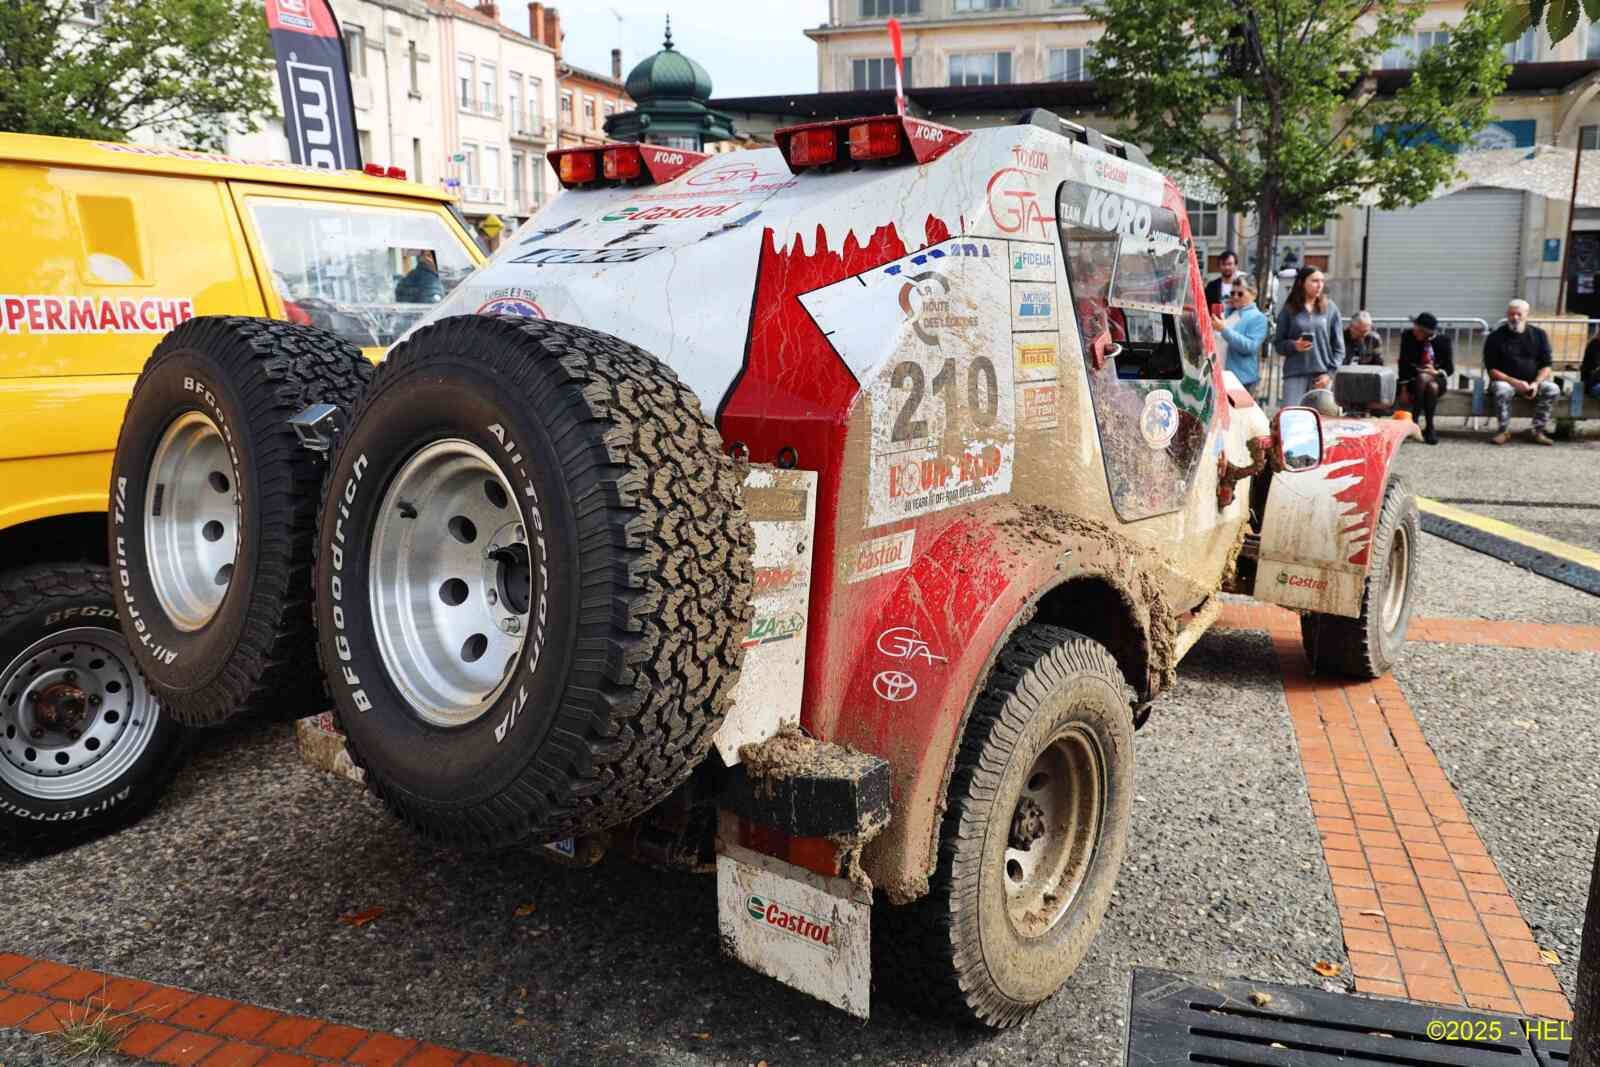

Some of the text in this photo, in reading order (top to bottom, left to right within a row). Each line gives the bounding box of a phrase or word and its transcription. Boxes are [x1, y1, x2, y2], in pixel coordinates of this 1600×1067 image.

[914, 125, 944, 142] KORO
[653, 151, 684, 165] KORO
[1012, 145, 1049, 172] TOYOTA
[628, 201, 743, 221] Castrol
[1083, 188, 1152, 236] KORO
[1022, 252, 1052, 267] FIDELIA
[890, 355, 999, 443] 210
[183, 376, 242, 549] BFGoo
[857, 541, 905, 573] Castrol
[116, 537, 178, 665] All-Terrain
[330, 453, 373, 713] BFGoodrich
[1288, 575, 1328, 591] Castrol
[877, 627, 949, 666] GTA
[494, 684, 529, 744] T/A
[766, 902, 833, 946] Castrol
